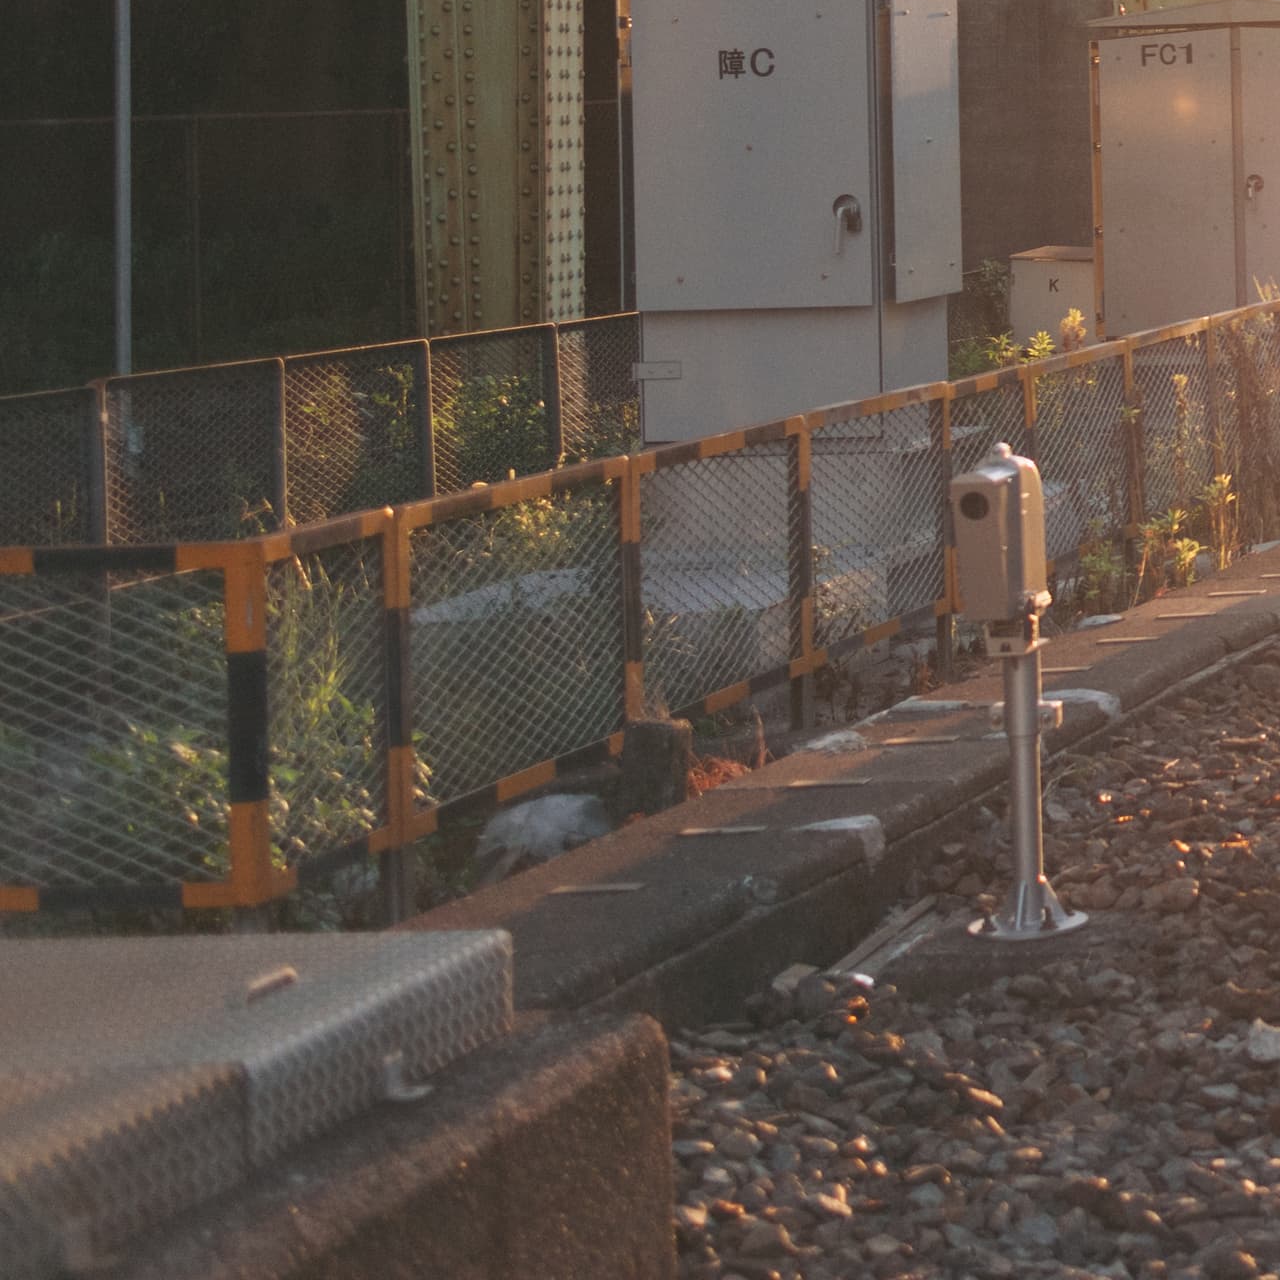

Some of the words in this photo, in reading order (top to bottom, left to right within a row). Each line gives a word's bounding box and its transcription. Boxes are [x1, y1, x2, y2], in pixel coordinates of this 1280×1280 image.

[718, 48, 775, 80] 障C
[1141, 43, 1193, 67] FC1
[1049, 278, 1060, 292] K
